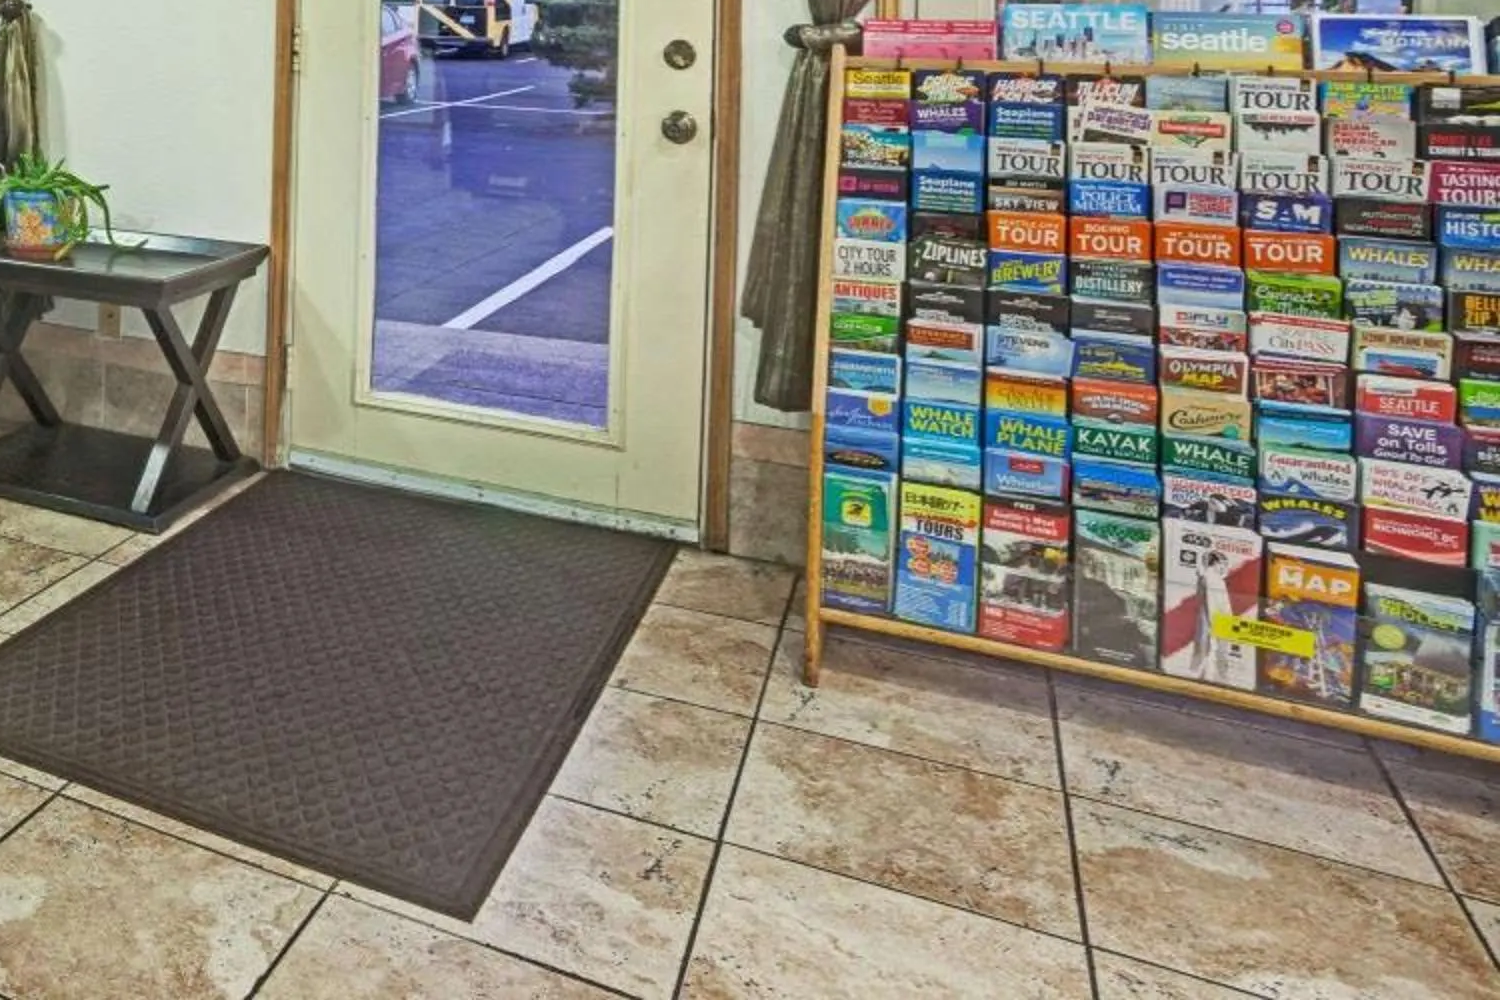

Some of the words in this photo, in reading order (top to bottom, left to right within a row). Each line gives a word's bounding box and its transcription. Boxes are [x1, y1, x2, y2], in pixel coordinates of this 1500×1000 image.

[1011, 10, 1138, 31] SEATTLE
[1160, 28, 1268, 53] seattle
[1239, 91, 1312, 111] TOUR
[917, 106, 967, 119] WHALES
[996, 107, 1055, 119] Seaplane
[997, 153, 1060, 176] TOUR
[1077, 161, 1142, 182] TOUR
[920, 176, 976, 189] Seaplane
[1155, 165, 1227, 186] TOUR
[1246, 172, 1320, 192] TOUR
[1348, 171, 1423, 196] TOUR
[995, 197, 1020, 209] SKY
[1026, 199, 1059, 211] VIEW
[1075, 200, 1141, 214] MUSEUM
[1080, 190, 1136, 205] POLICE
[1438, 189, 1500, 206] TOUR
[996, 225, 1059, 247] TOUR
[1076, 234, 1141, 255] TOUR
[838, 246, 864, 262] CITY
[866, 247, 898, 263] TOUR
[922, 241, 986, 268] ZIPLINES
[1162, 237, 1233, 260] TOUR
[1250, 242, 1324, 264] TOUR
[1348, 247, 1429, 268] WHALES
[843, 261, 852, 273] 2
[854, 262, 892, 277] HOURS
[992, 260, 1061, 282] BREWERY
[835, 283, 897, 300] ANTIQUES
[1075, 276, 1143, 294] DISTILLERY
[1169, 359, 1237, 378] OLYMPIA
[910, 405, 974, 423] WHALE
[1379, 396, 1440, 413] SEATTLE
[910, 417, 974, 438] WATCH
[999, 417, 1066, 441] WHALE
[1387, 423, 1437, 440] SAVE
[996, 431, 1066, 454] PLANE
[1077, 429, 1151, 452] KAYAK
[1377, 437, 1400, 448] on
[1405, 439, 1448, 455] Tolls
[1173, 441, 1250, 469] WHALE
[1261, 498, 1347, 520] WHALES
[916, 519, 964, 540] TOURS
[1279, 564, 1352, 596] MAP
